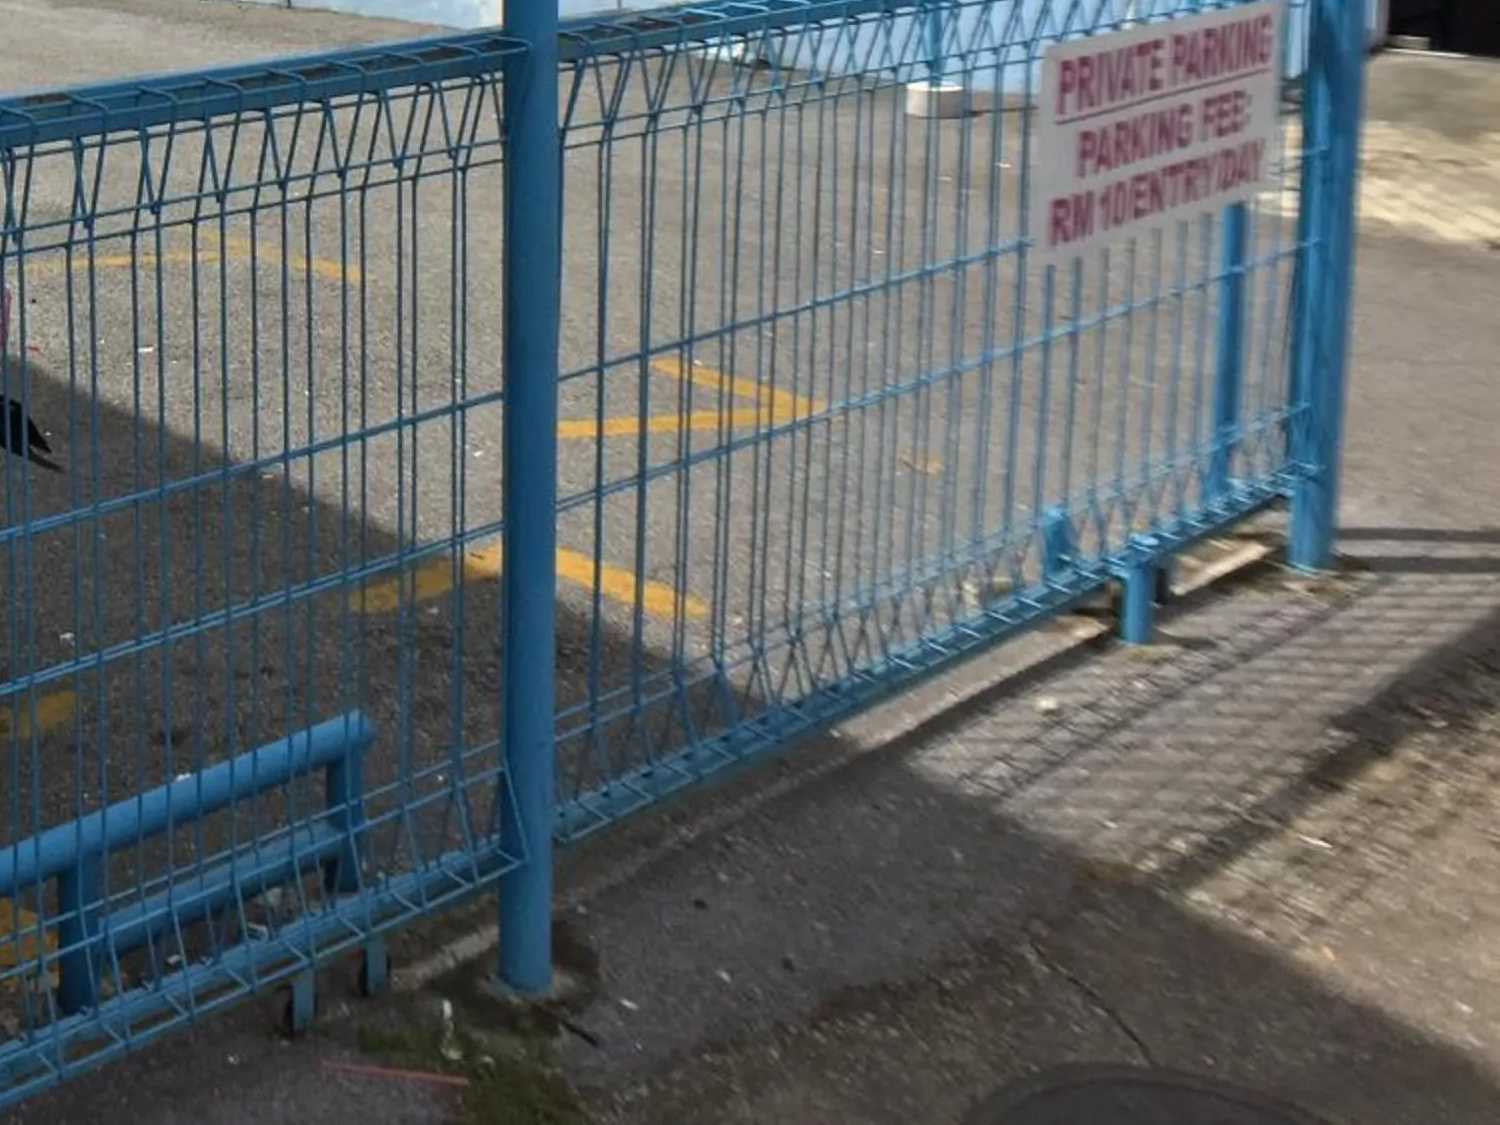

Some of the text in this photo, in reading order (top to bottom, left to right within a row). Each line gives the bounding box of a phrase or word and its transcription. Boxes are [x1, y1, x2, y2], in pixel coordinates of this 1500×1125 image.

[1056, 13, 1273, 115] PRIVATE PARKING
[1077, 103, 1193, 177] PARKING
